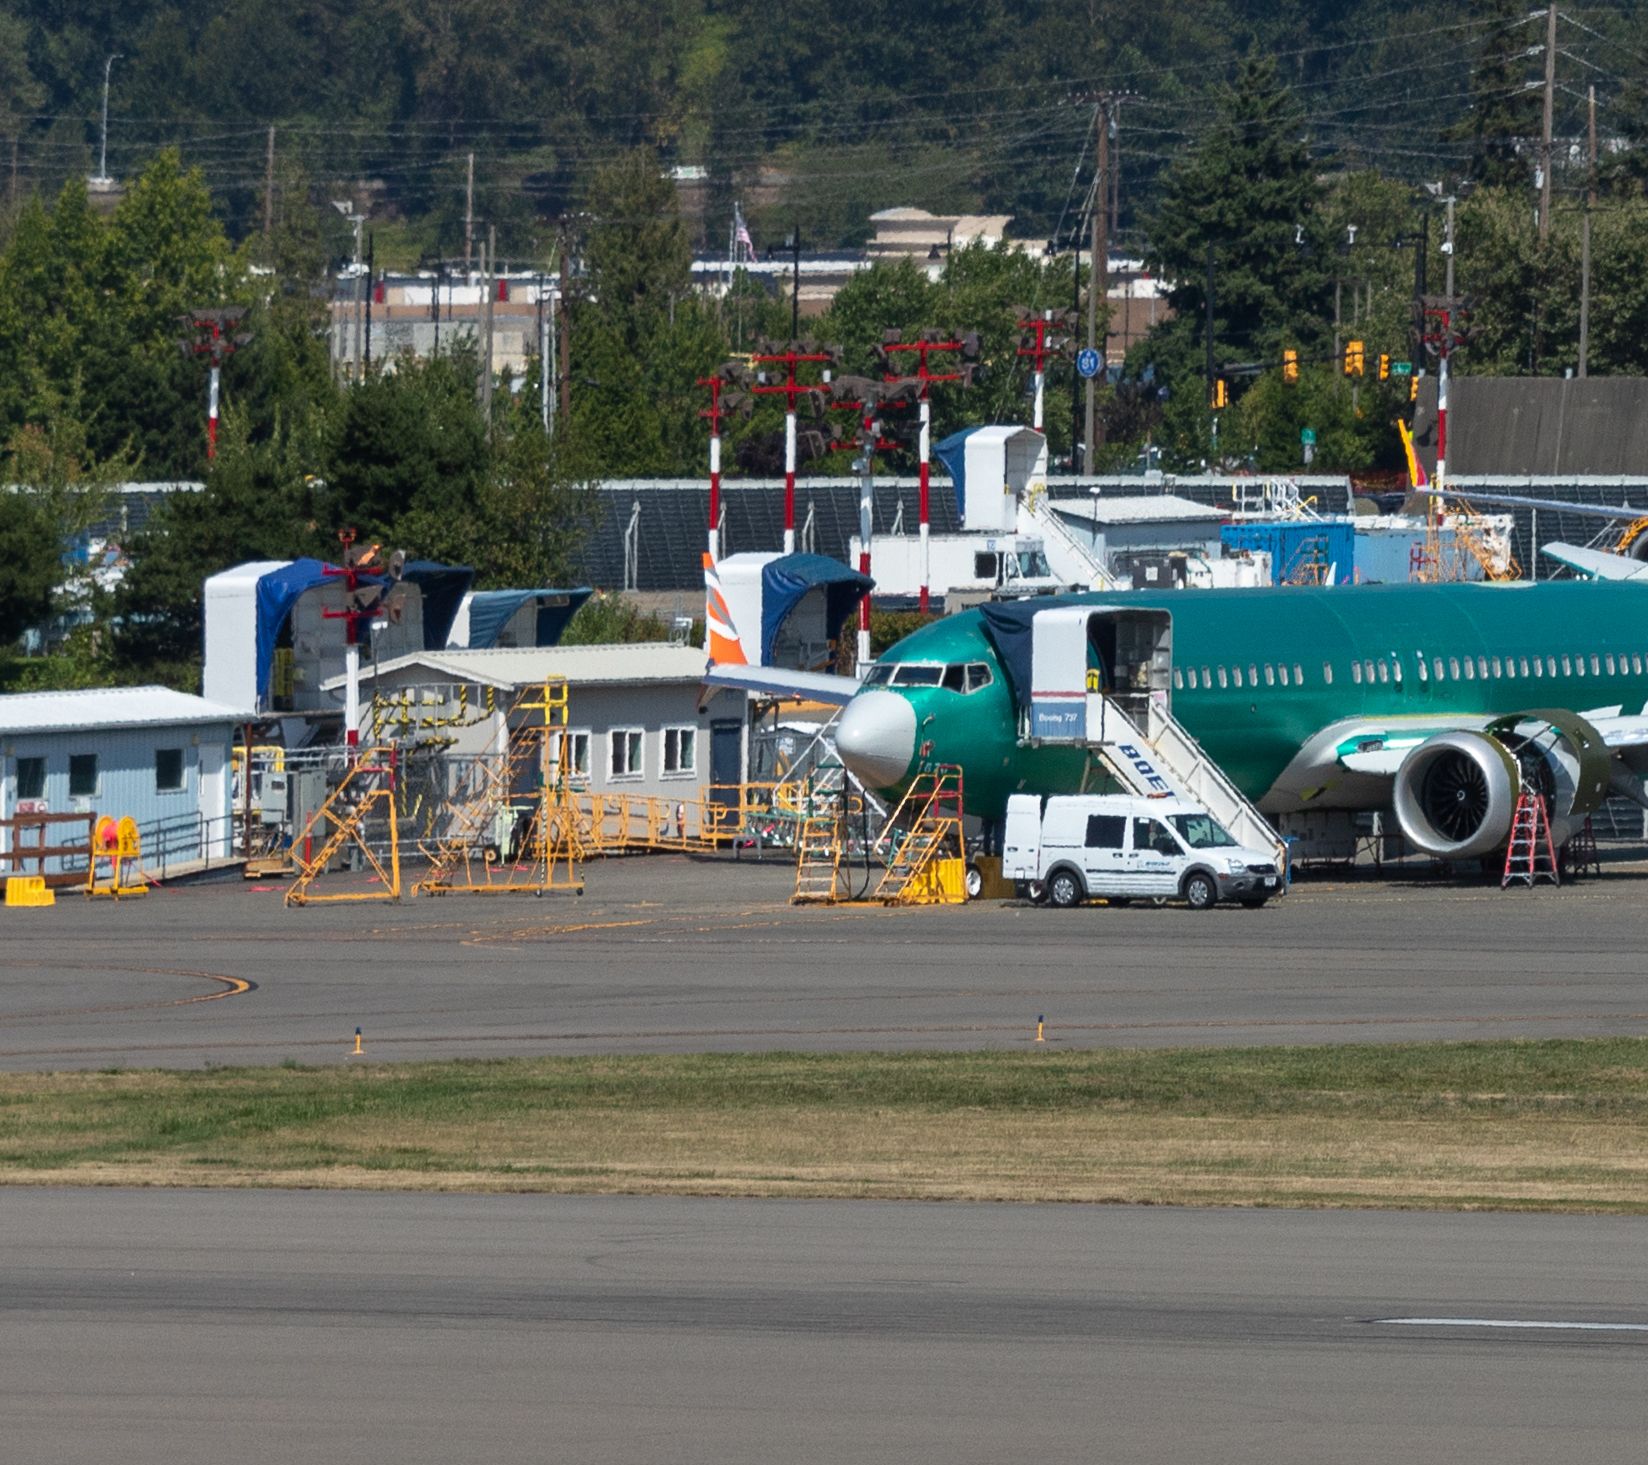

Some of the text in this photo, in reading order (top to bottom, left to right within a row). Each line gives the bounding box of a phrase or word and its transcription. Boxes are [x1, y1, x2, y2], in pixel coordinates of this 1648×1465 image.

[1038, 712, 1078, 722] Boeing 737
[1118, 744, 1175, 797] BOE
